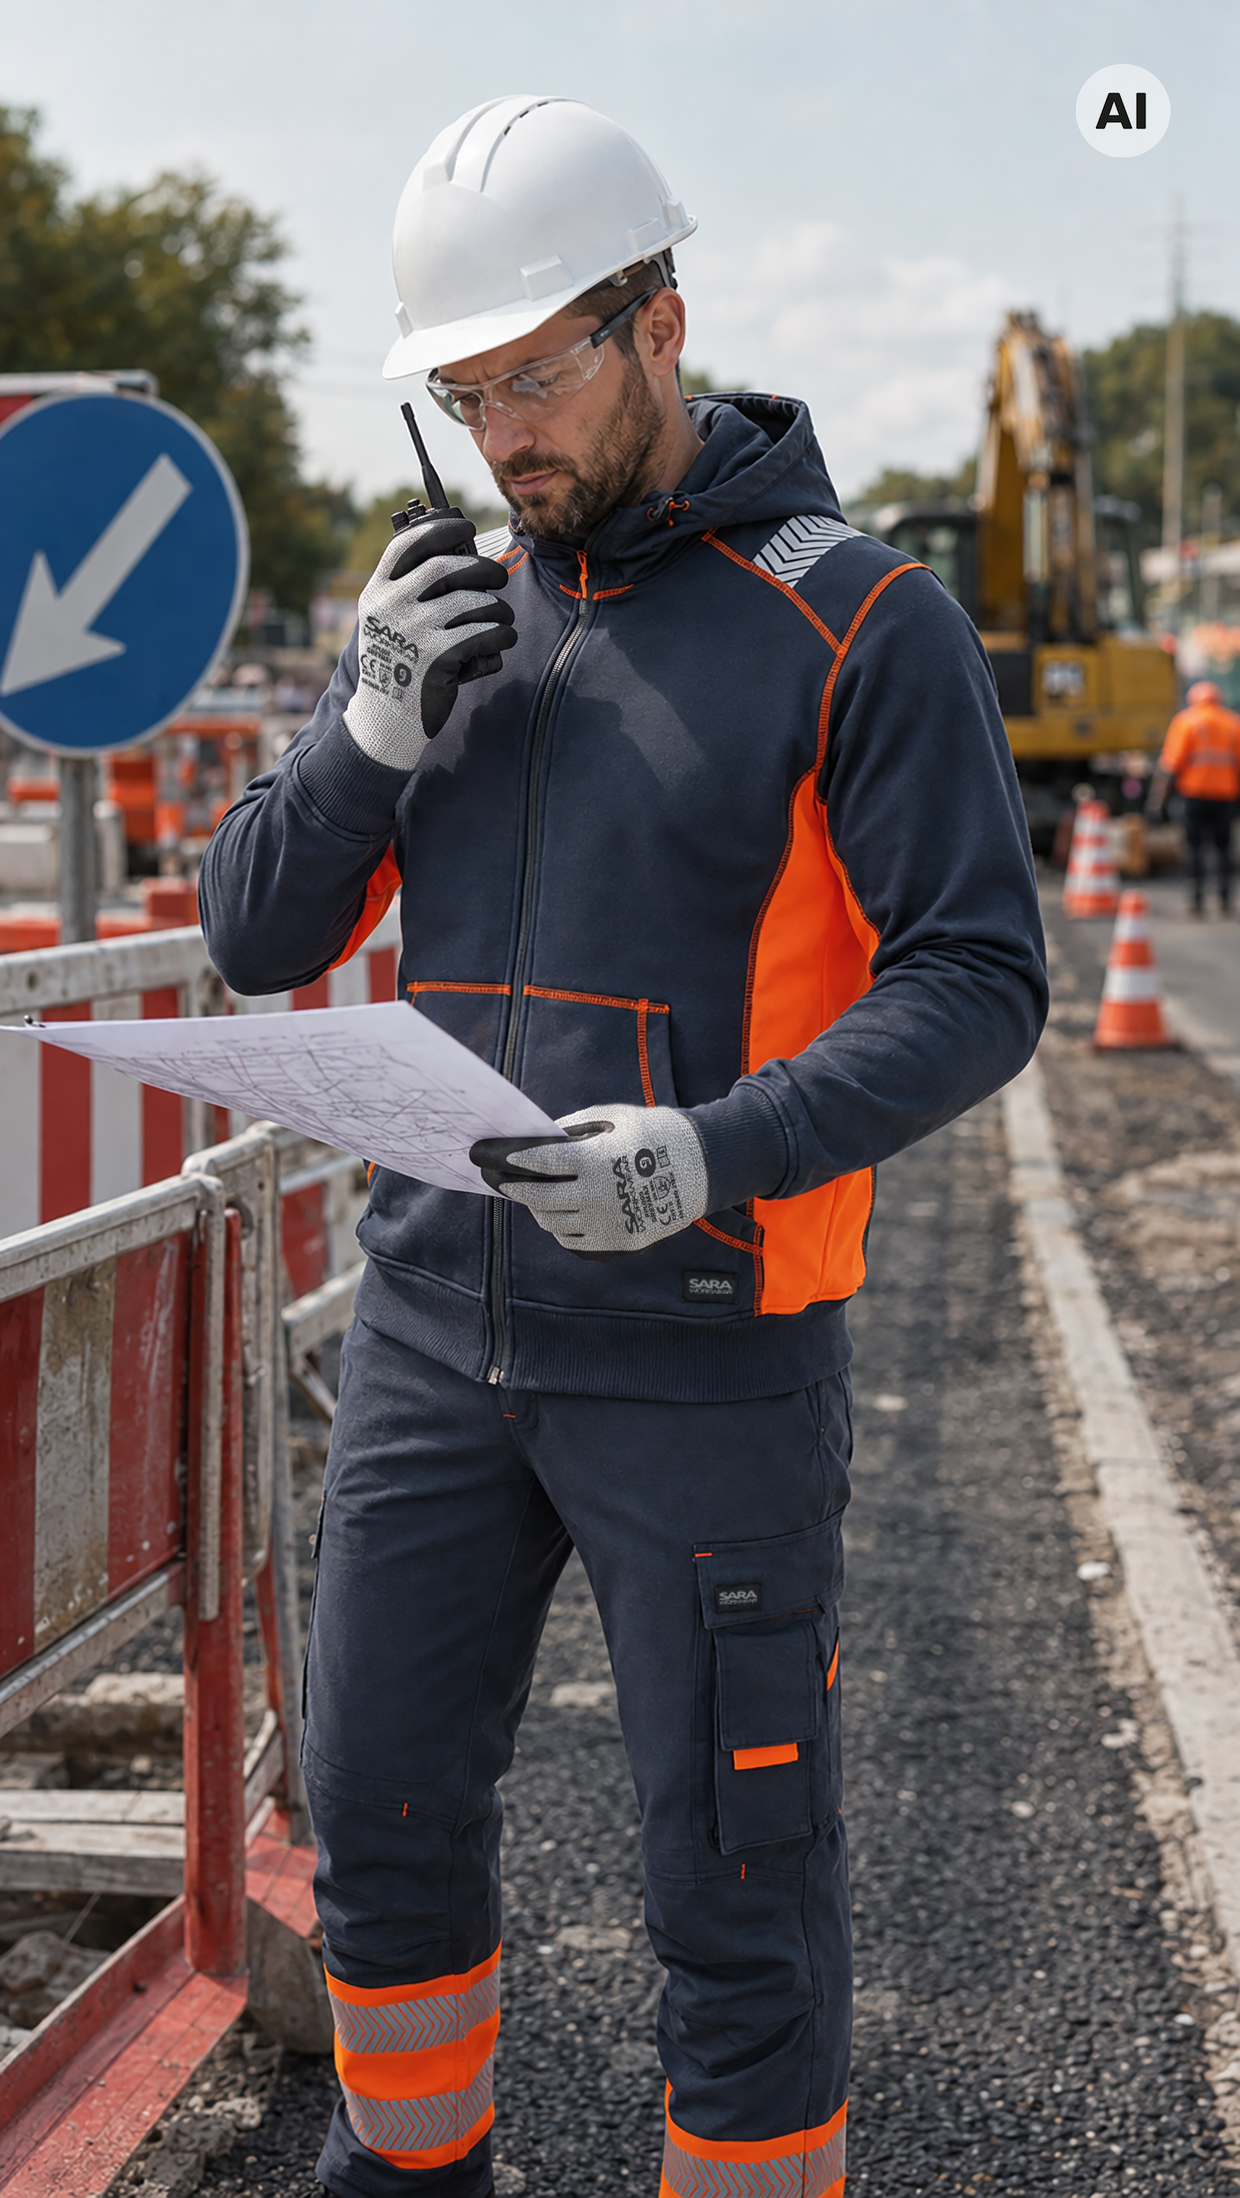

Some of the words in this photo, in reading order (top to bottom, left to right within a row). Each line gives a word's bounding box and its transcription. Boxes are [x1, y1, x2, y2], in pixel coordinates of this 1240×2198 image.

[364, 616, 419, 659] SARA
[613, 1157, 640, 1234] SARA
[622, 1155, 646, 1232] WORKWEAR
[688, 1278, 733, 1290] SARA
[719, 1590, 758, 1600] SARA
